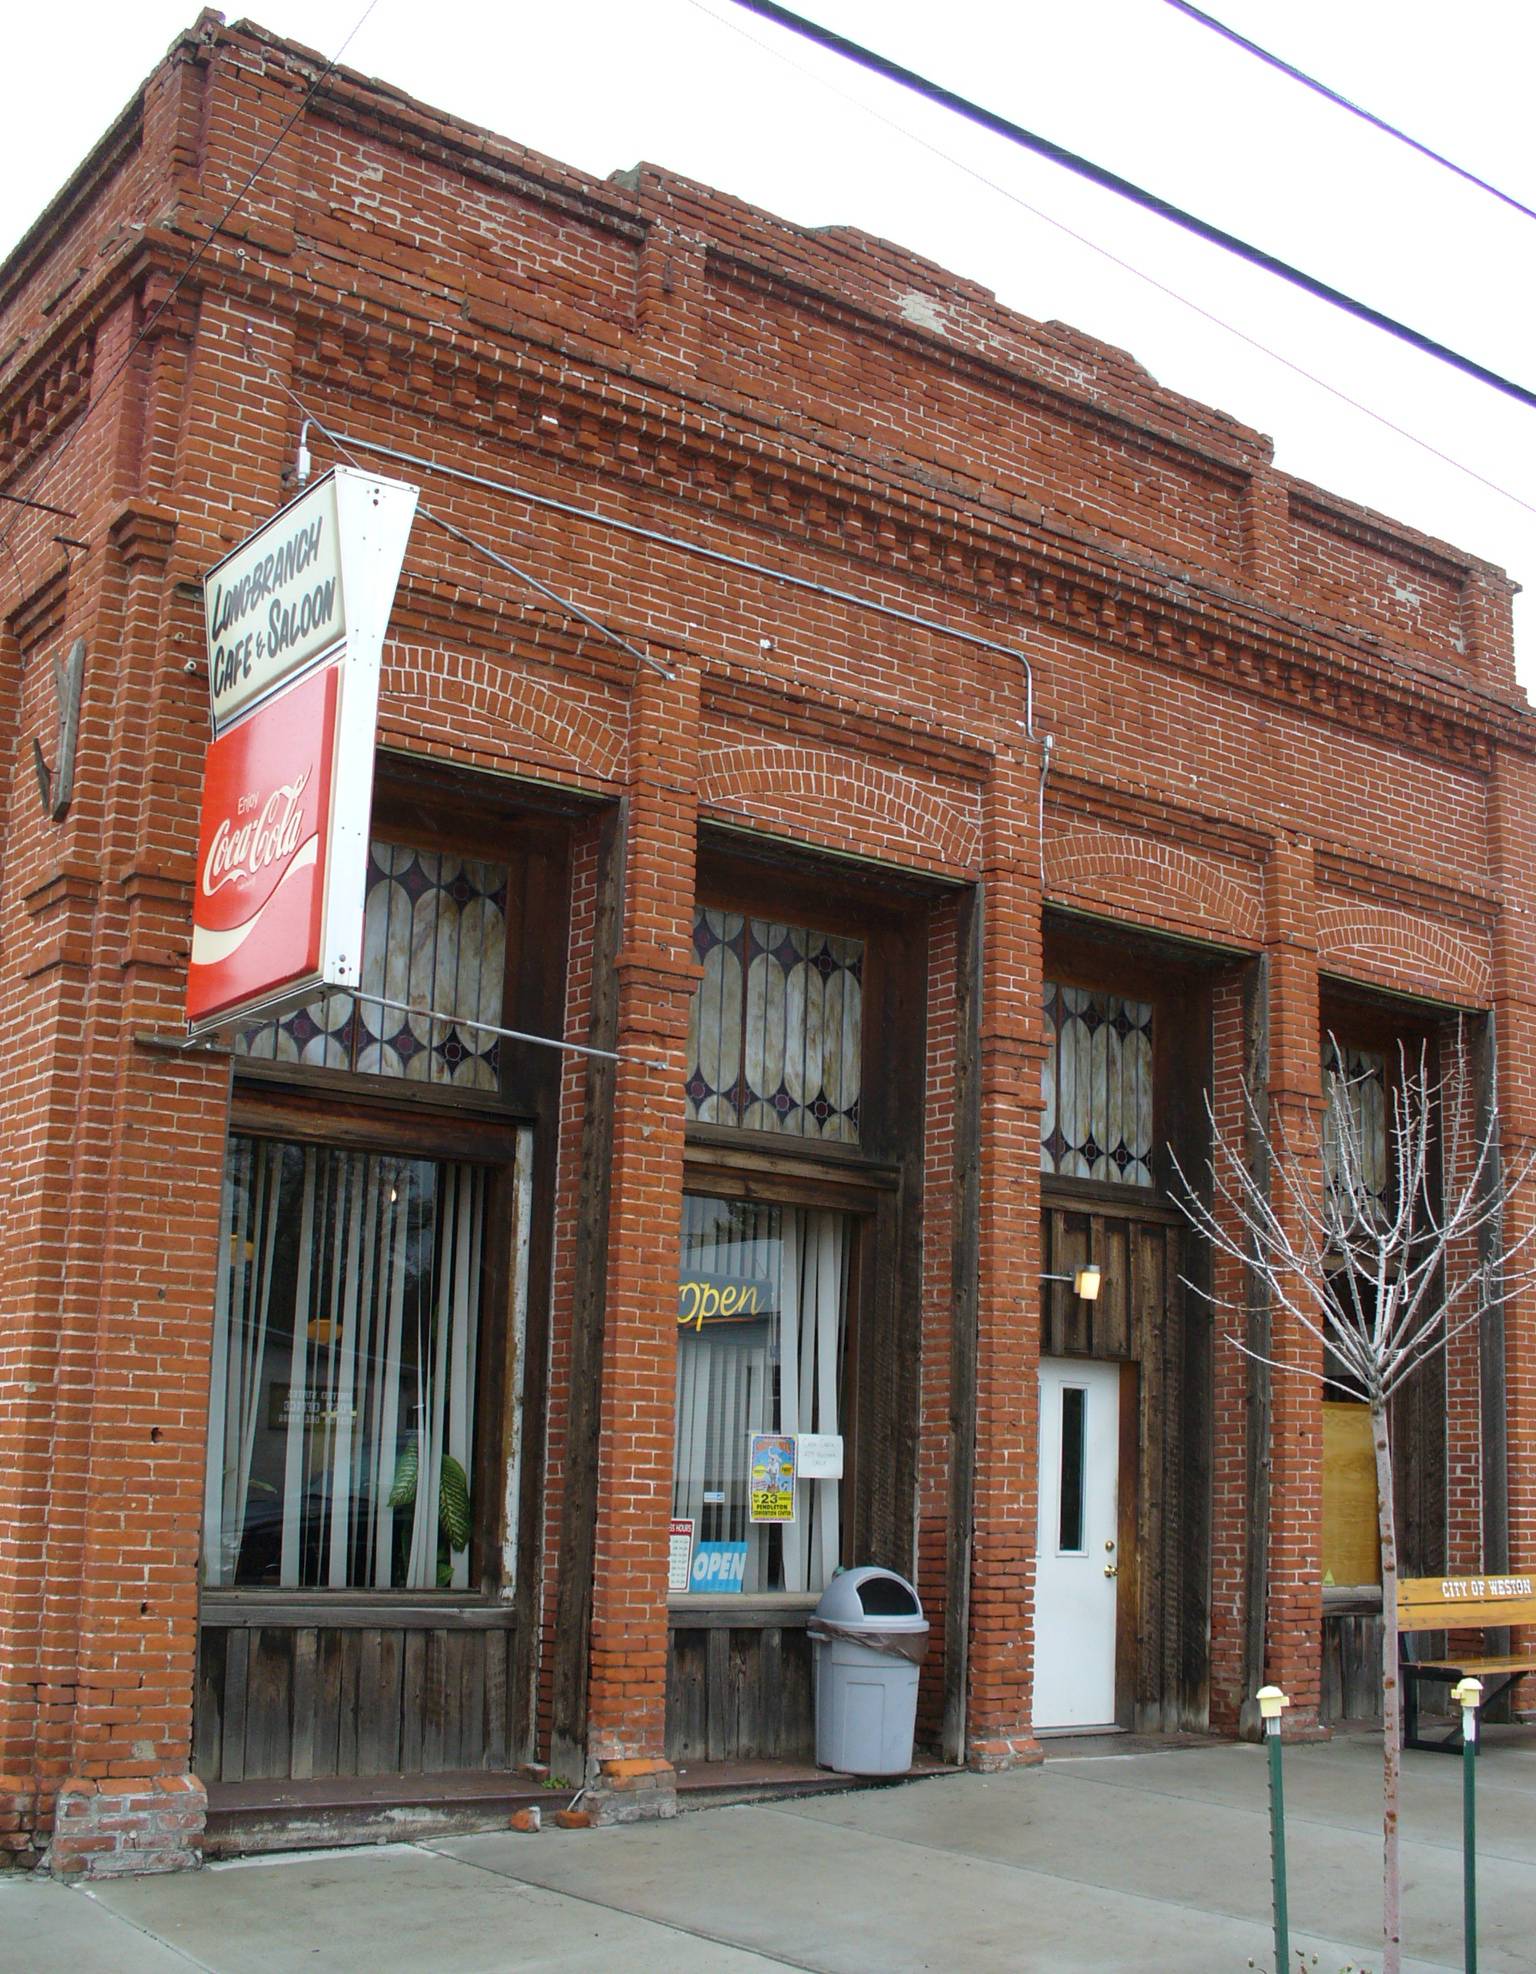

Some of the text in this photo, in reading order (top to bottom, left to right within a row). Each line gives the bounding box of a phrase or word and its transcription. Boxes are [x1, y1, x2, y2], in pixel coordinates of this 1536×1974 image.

[212, 516, 323, 642] LONGBRANCH
[214, 576, 337, 698] CAFE & SALOON
[238, 791, 260, 815] Enjoy
[203, 766, 312, 896] Coca-Cola
[677, 1280, 766, 1332] Open
[761, 1493, 778, 1504] 23
[693, 1551, 747, 1581] OPEN
[1442, 1579, 1532, 1598] CITY OF WESTON
